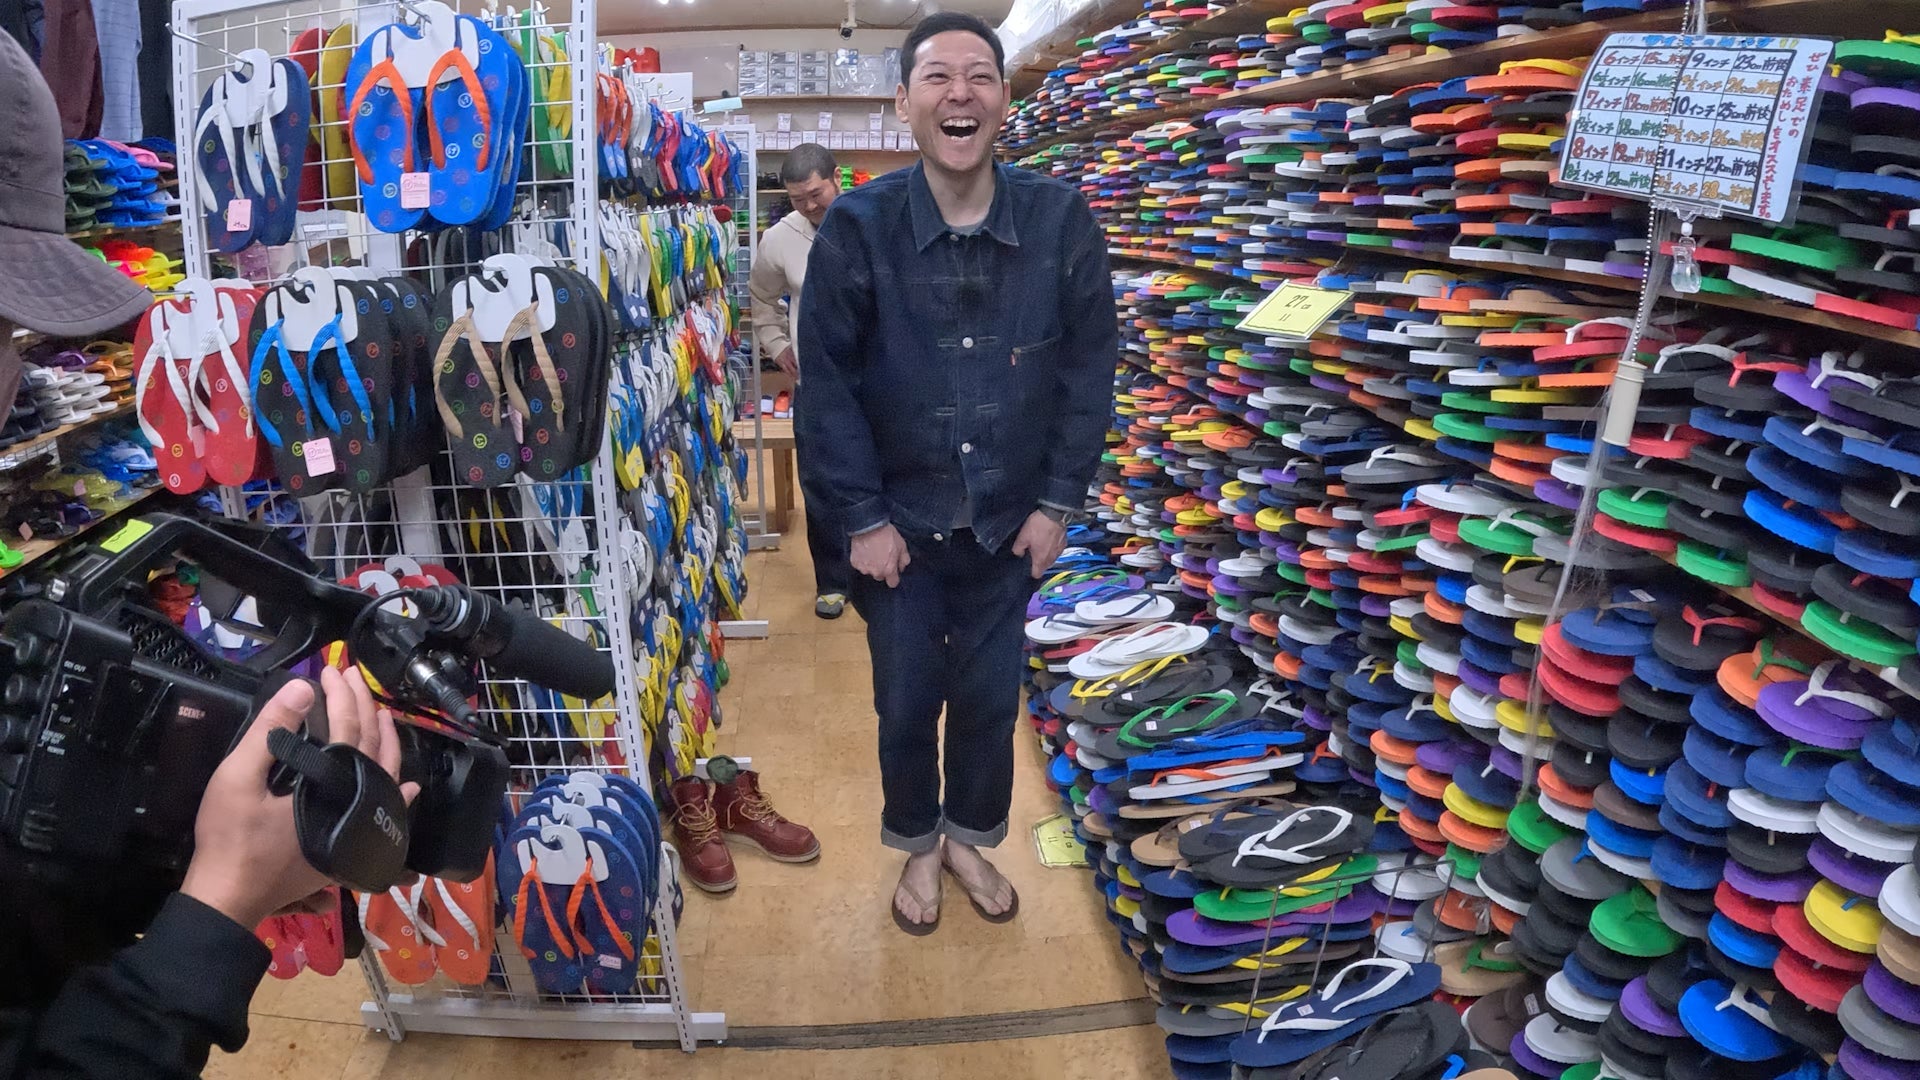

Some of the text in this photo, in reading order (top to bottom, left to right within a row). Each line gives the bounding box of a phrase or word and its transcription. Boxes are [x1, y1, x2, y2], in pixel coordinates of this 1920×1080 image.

[1603, 50, 1641, 66] 6インチ
[1692, 53, 1789, 71] 9インチ 23cm前後
[1586, 90, 1622, 109] 7インチ
[1672, 96, 1771, 121] 10インチ 25cm前後
[1572, 136, 1609, 160] 8インチ
[1660, 148, 1759, 178] 11インチ 27cm前後
[373, 806, 404, 846] SONY
